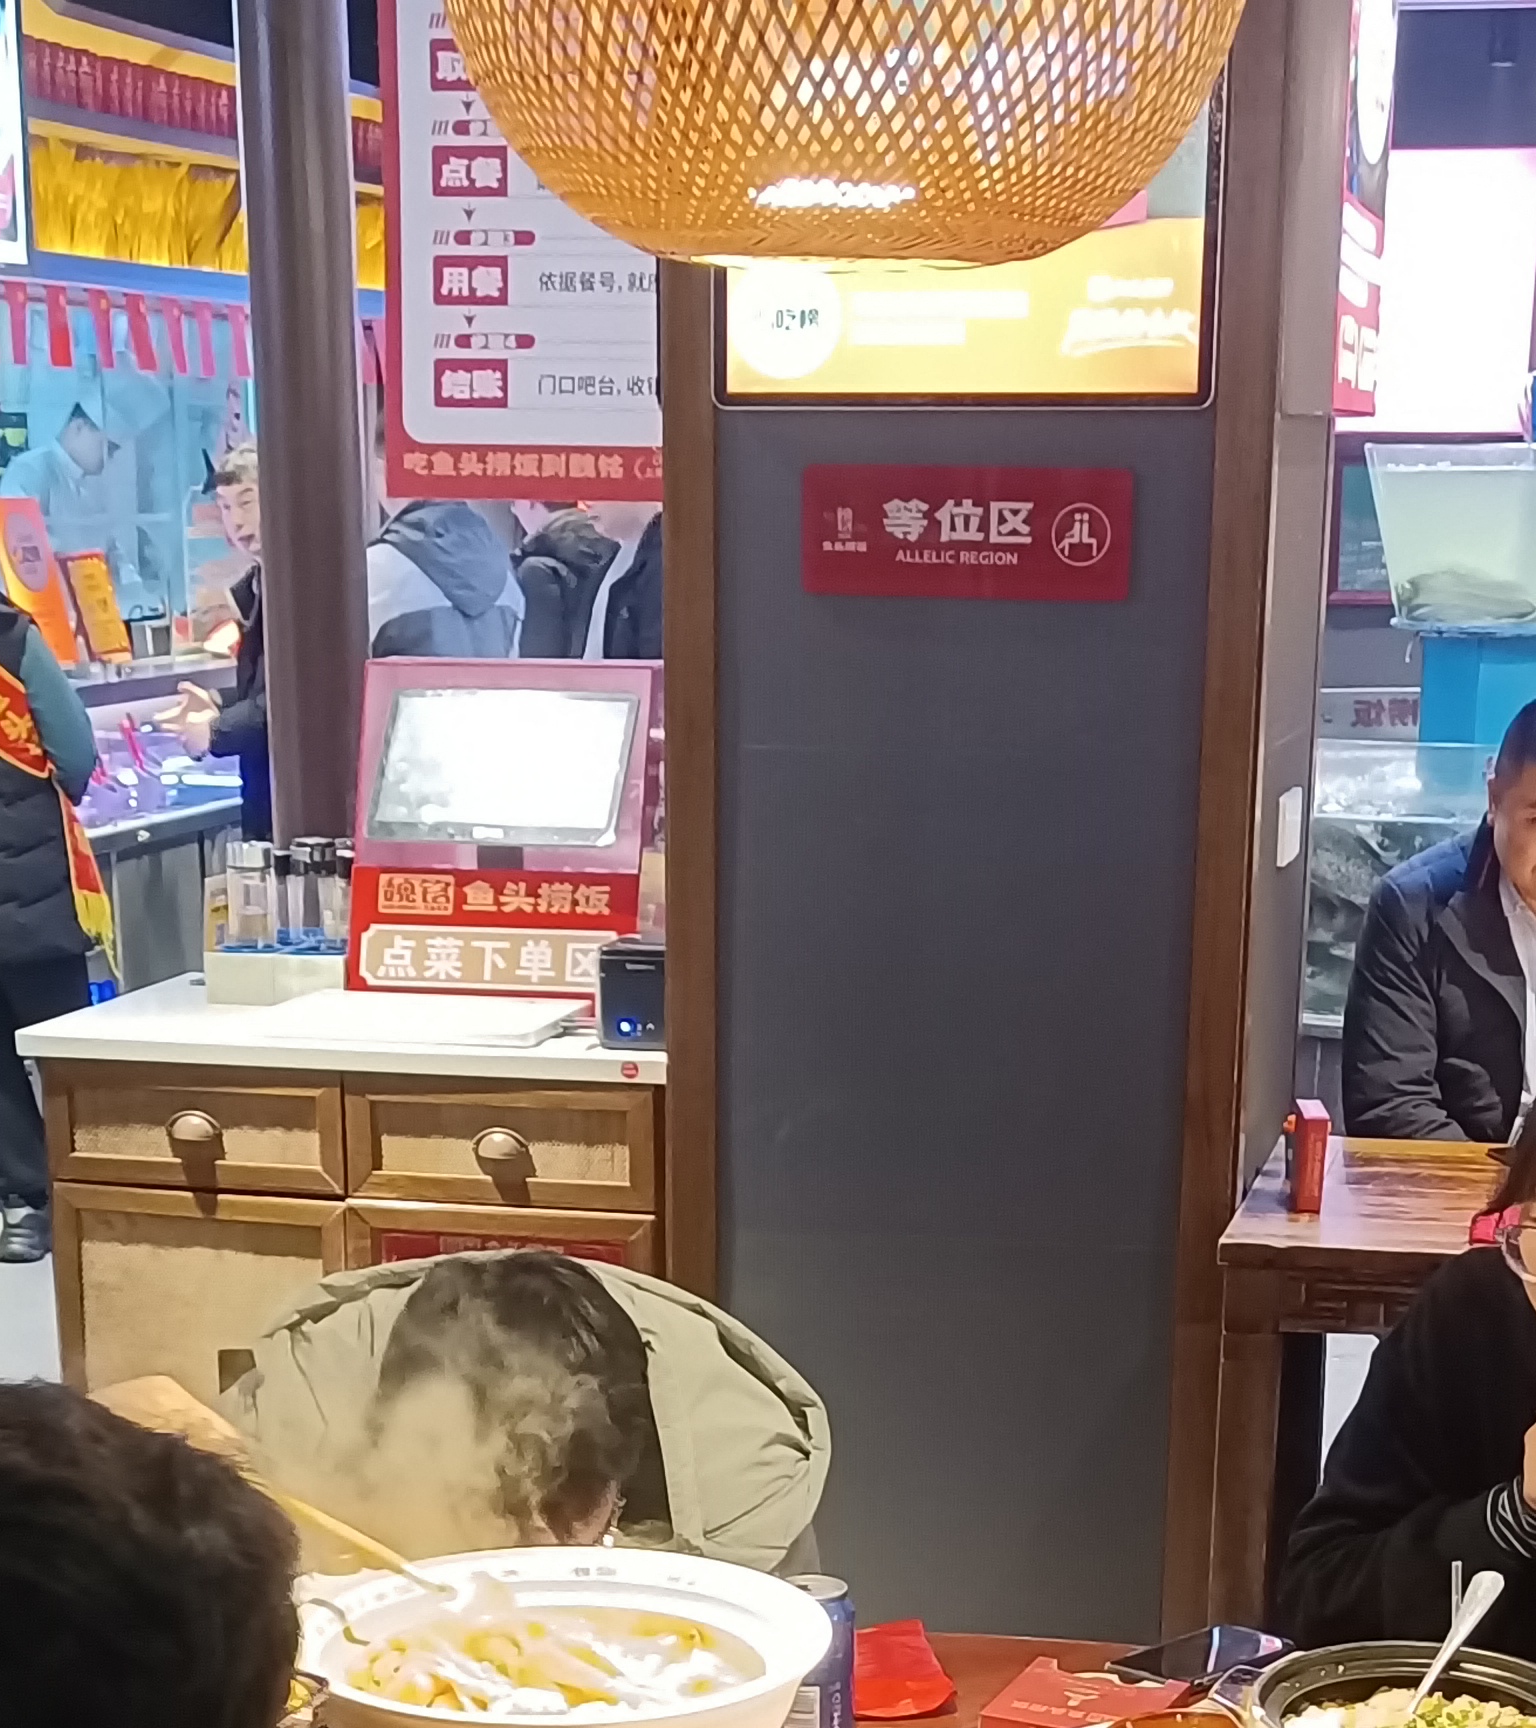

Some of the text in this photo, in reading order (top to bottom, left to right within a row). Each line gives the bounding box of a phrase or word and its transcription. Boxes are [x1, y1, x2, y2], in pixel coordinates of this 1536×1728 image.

[440, 265, 503, 298] 用餐
[441, 369, 504, 400] 结账
[882, 498, 1034, 544] 等位区
[895, 549, 1018, 566] ALLELIC REGION
[462, 879, 611, 916] 鱼头捞饭
[377, 934, 599, 983] 点菜下单区
